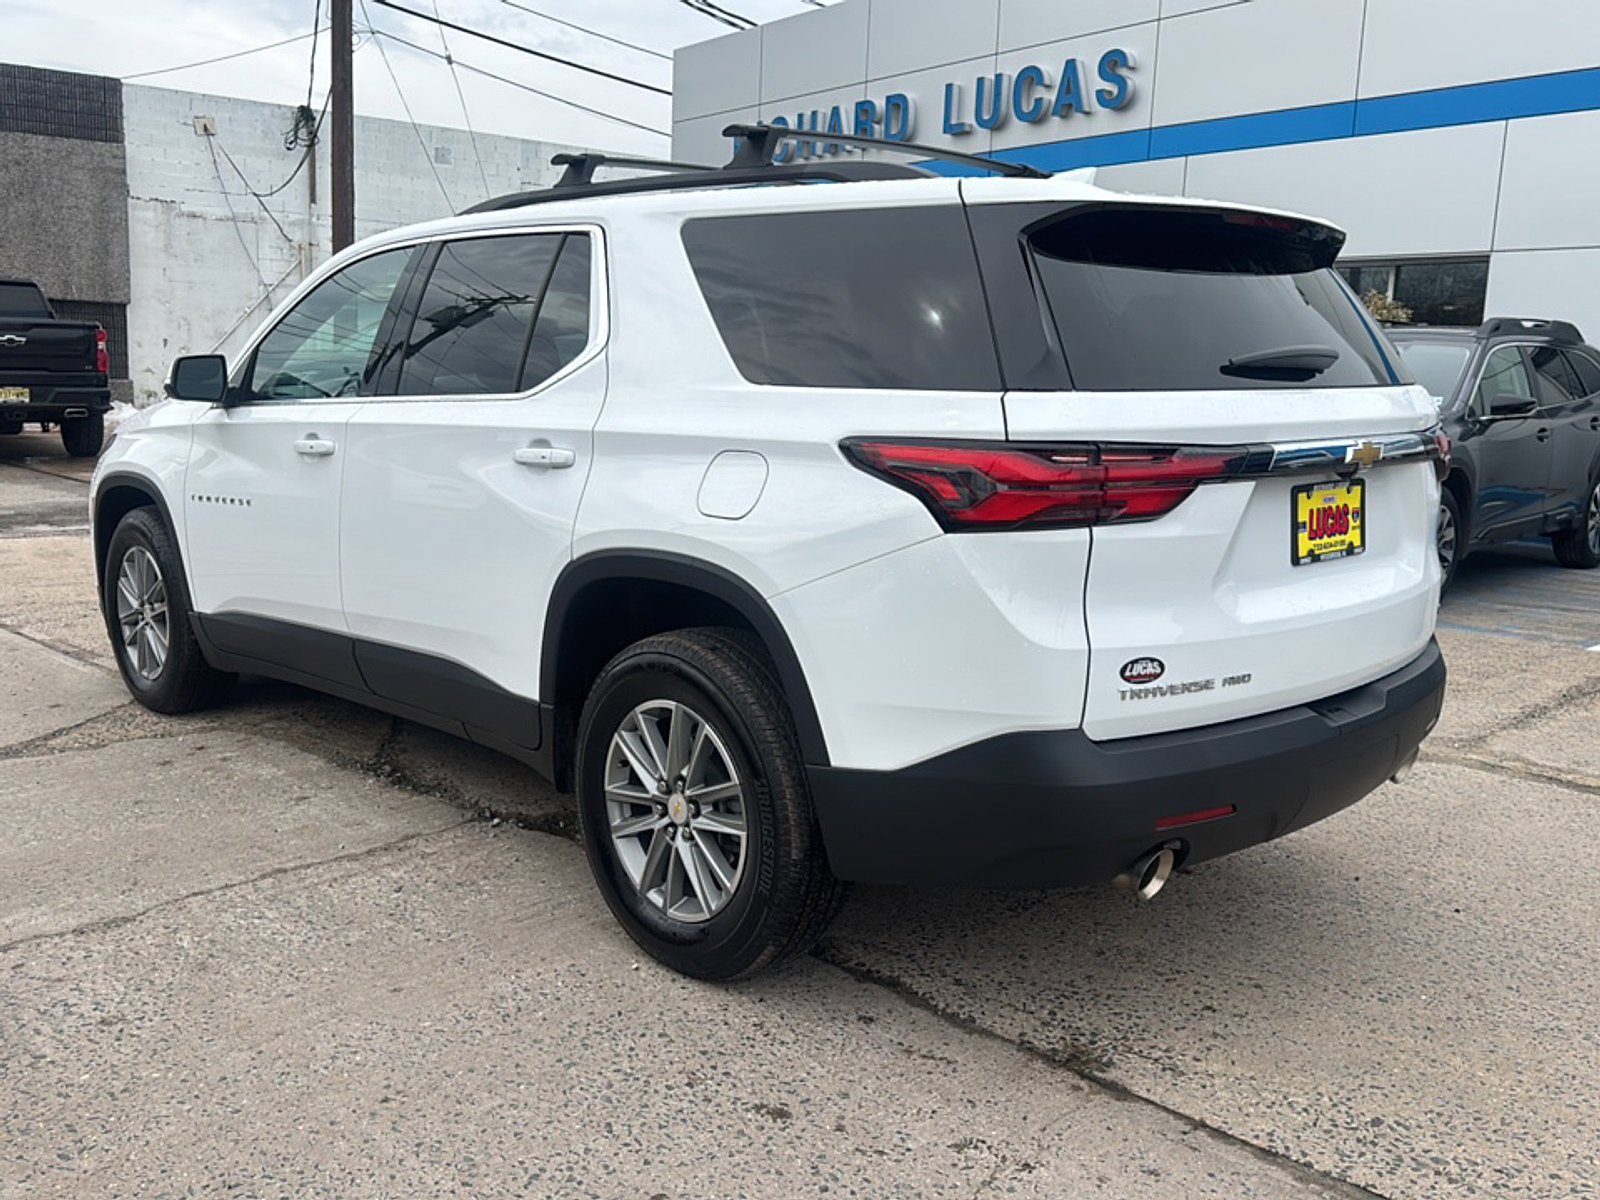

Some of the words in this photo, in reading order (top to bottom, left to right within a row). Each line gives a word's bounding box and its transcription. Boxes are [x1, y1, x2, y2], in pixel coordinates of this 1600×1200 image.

[943, 48, 1135, 135] LUCAS
[1309, 504, 1350, 540] LUCAS
[1123, 660, 1162, 676] LUCAS
[1119, 679, 1214, 701] TRAVERSE
[1221, 673, 1252, 688] AWD
[755, 781, 775, 898] BRIDGESTONE
